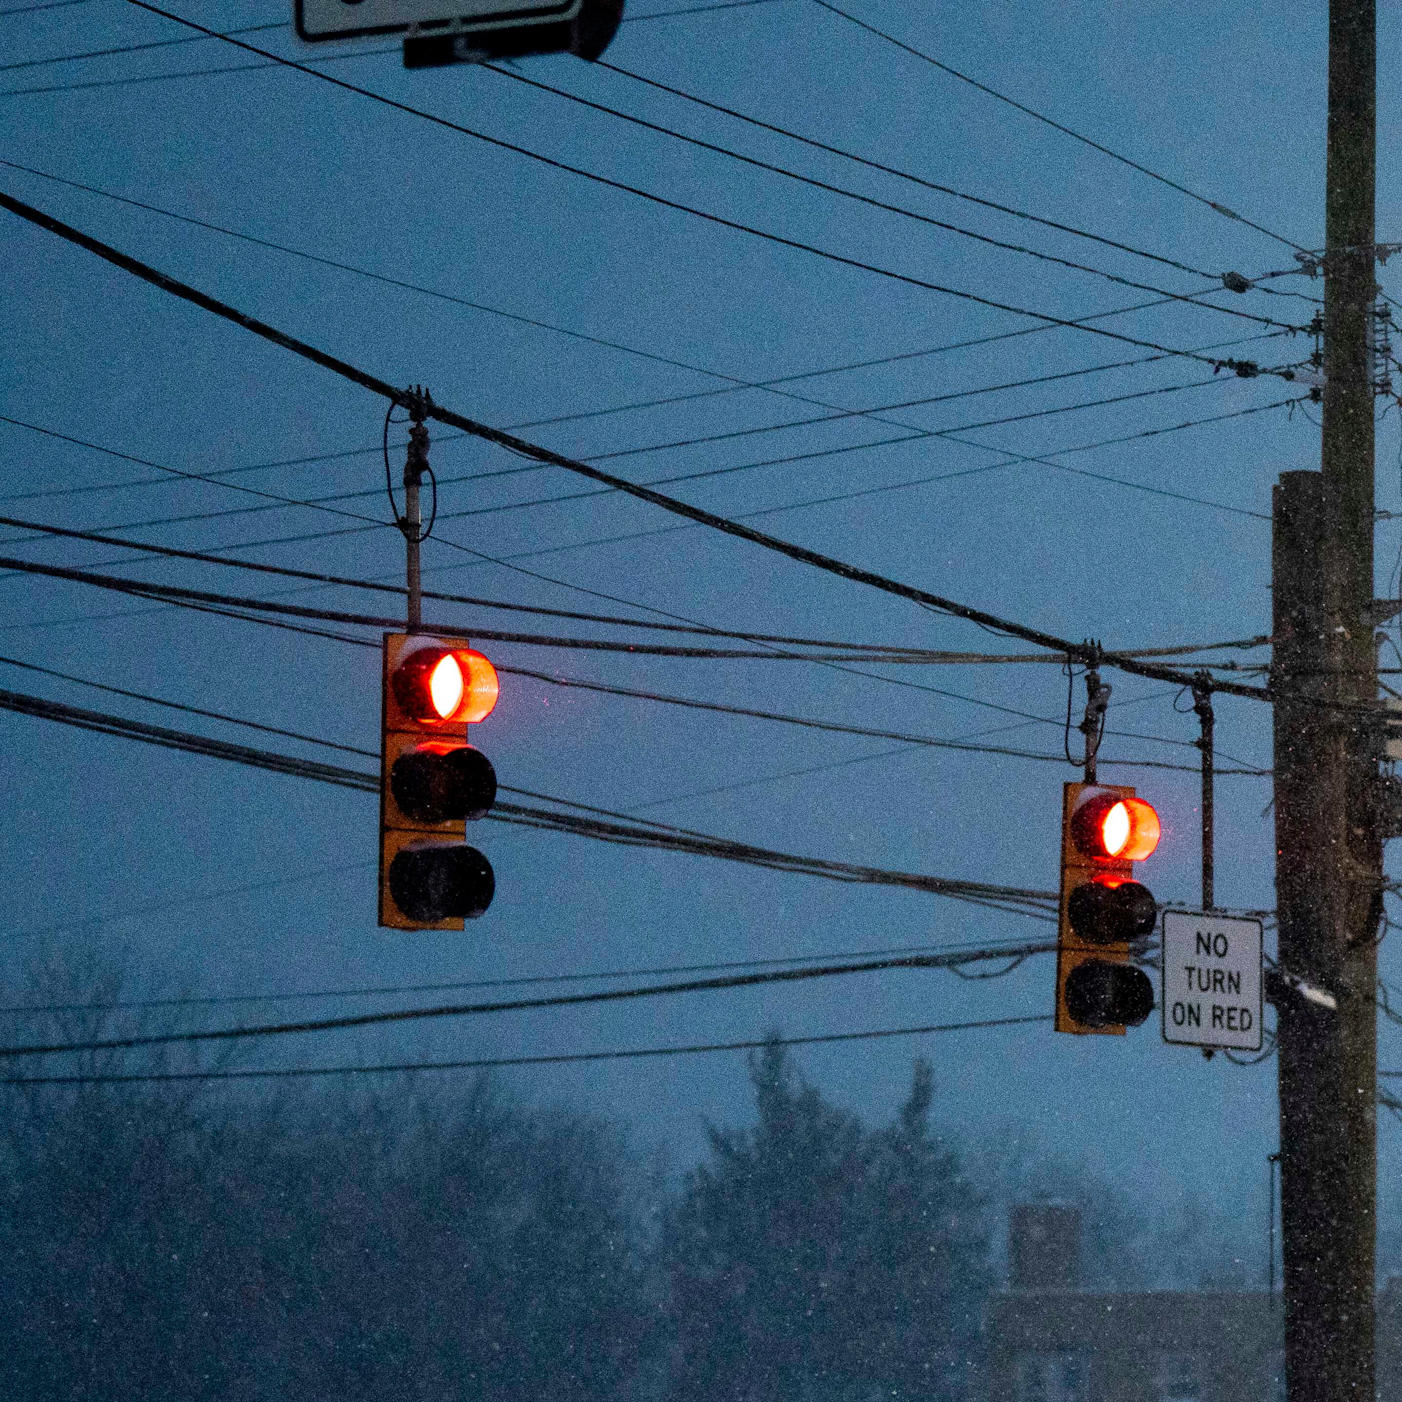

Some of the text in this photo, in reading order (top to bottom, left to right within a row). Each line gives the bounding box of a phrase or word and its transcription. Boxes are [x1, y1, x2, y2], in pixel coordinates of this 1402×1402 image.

[1195, 931, 1229, 958] NO
[1184, 966, 1241, 995] TURN
[1172, 1002, 1253, 1032] ON RED
